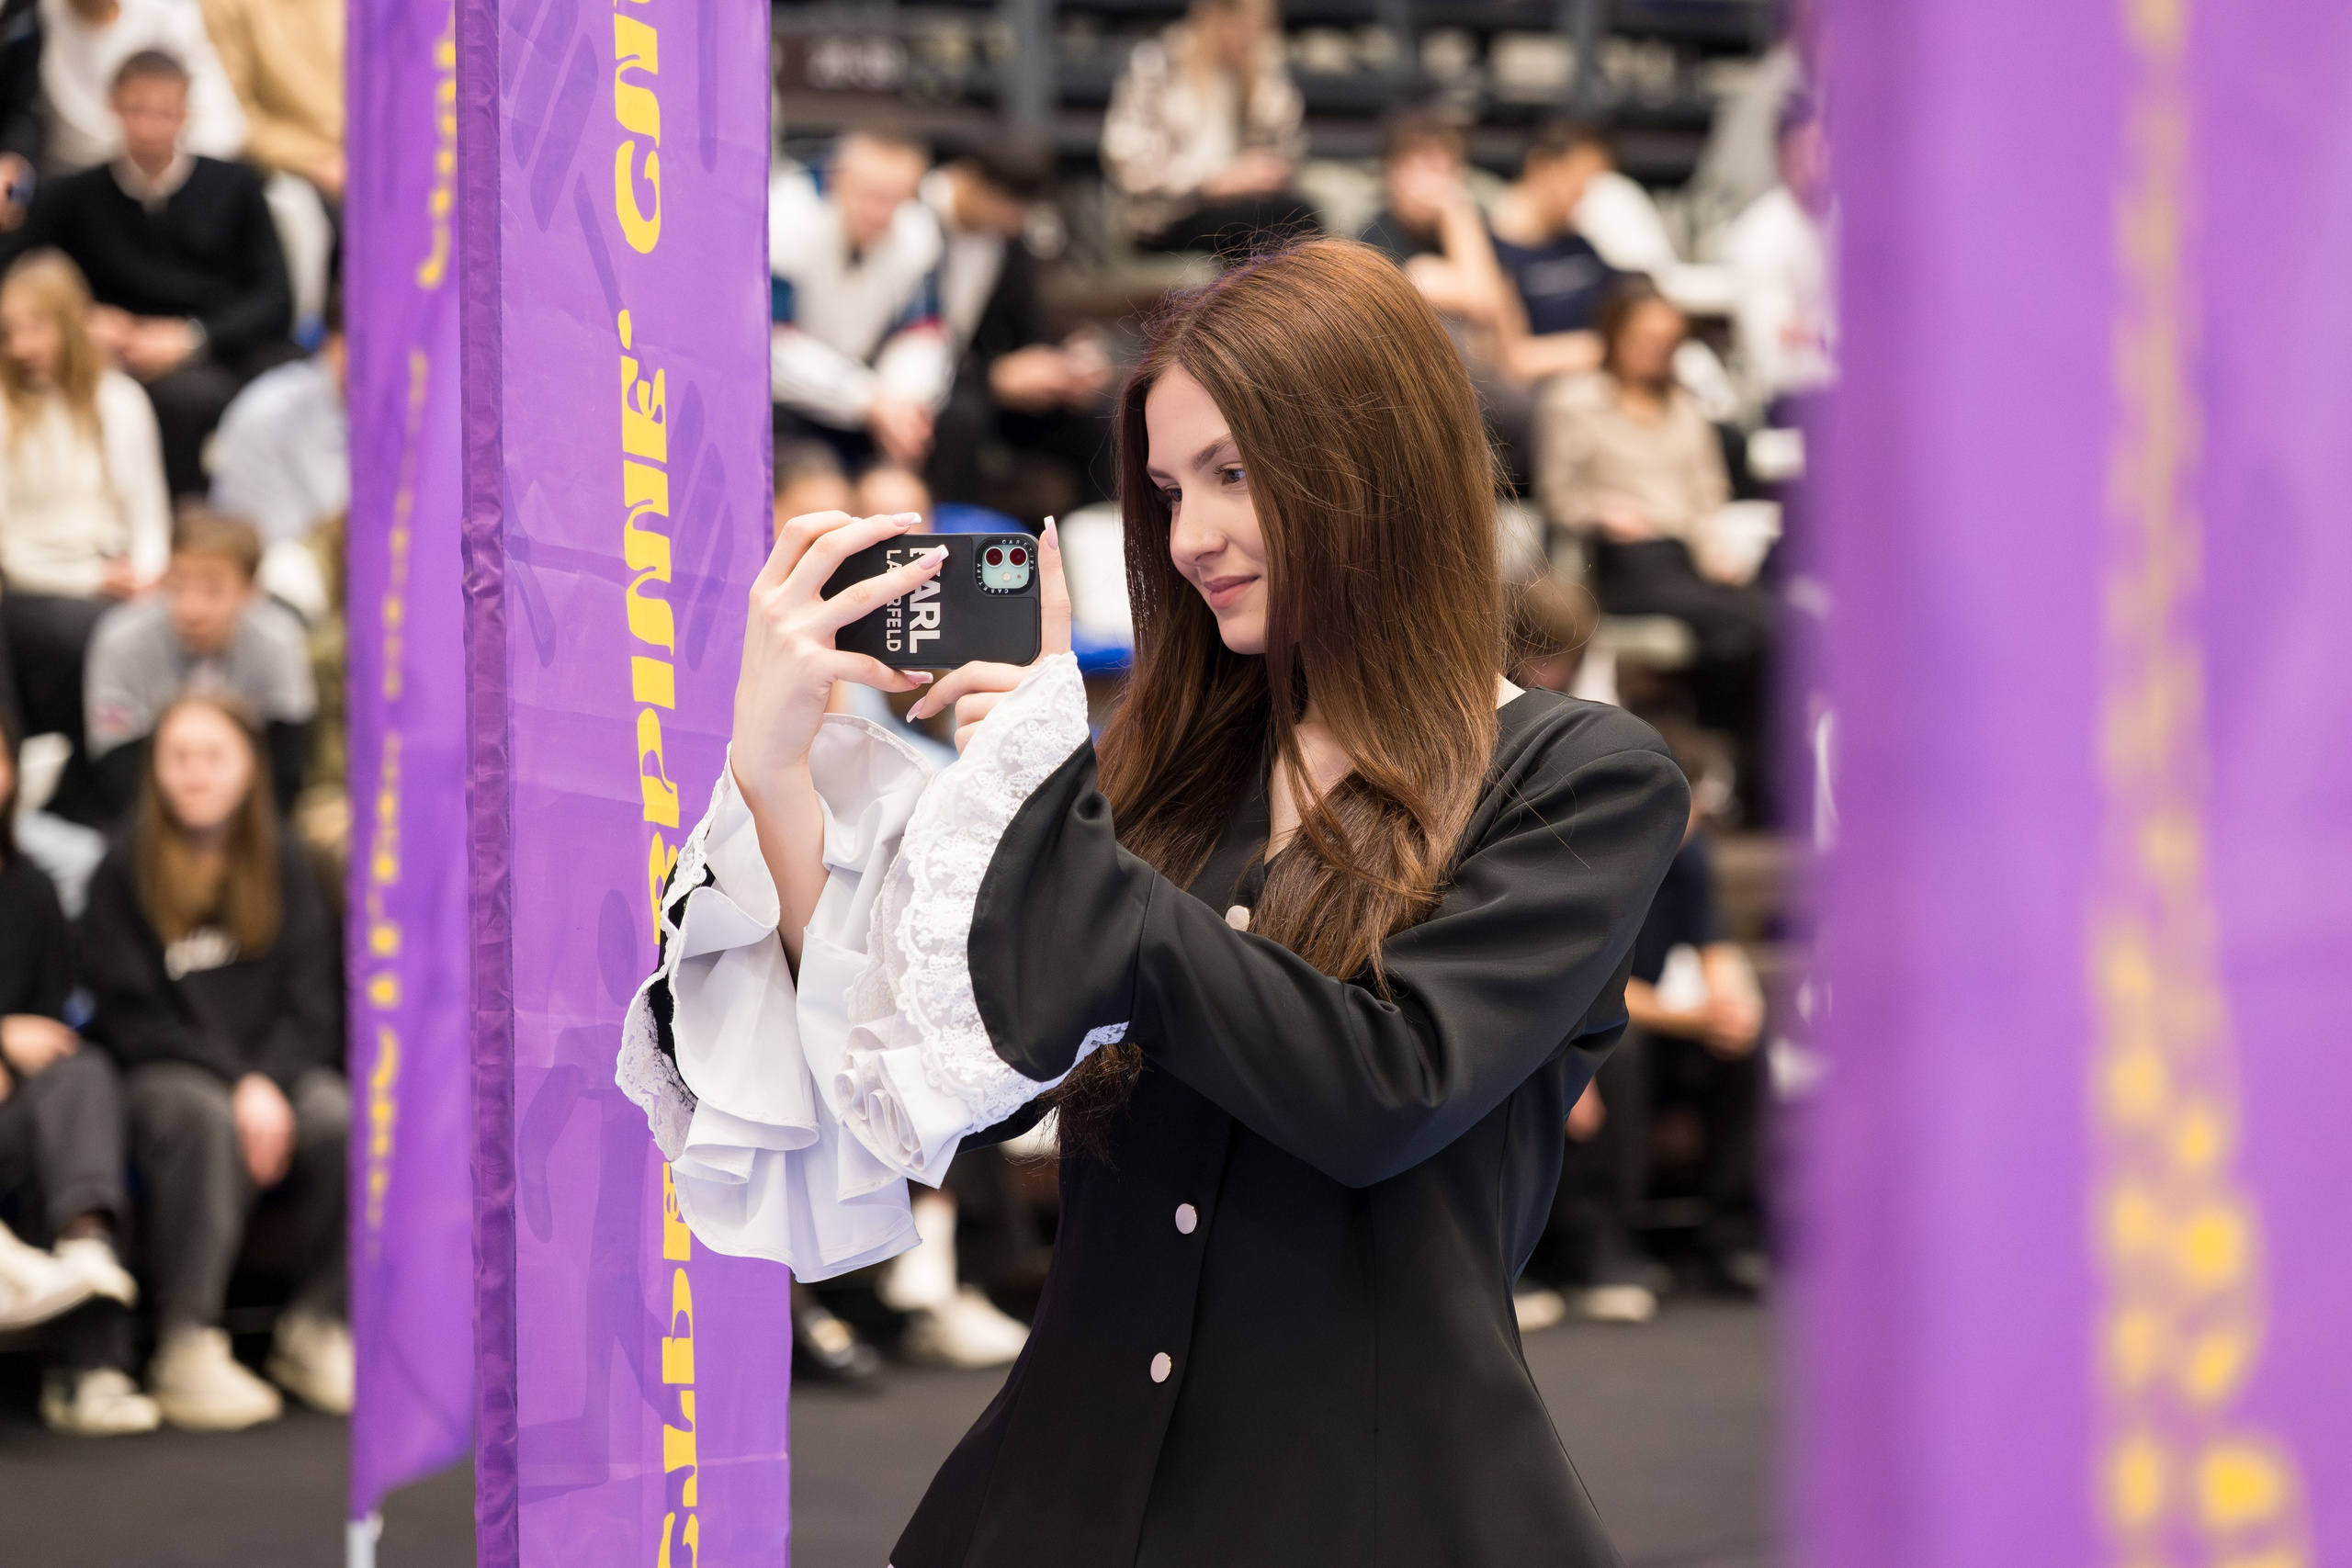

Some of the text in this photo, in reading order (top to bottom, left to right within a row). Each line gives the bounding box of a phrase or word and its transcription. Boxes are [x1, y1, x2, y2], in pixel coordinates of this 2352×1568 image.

[1001, 539, 1035, 570] CASETIFY
[977, 563, 1009, 593] CASETIFY
[887, 549, 901, 652] LARFELD
